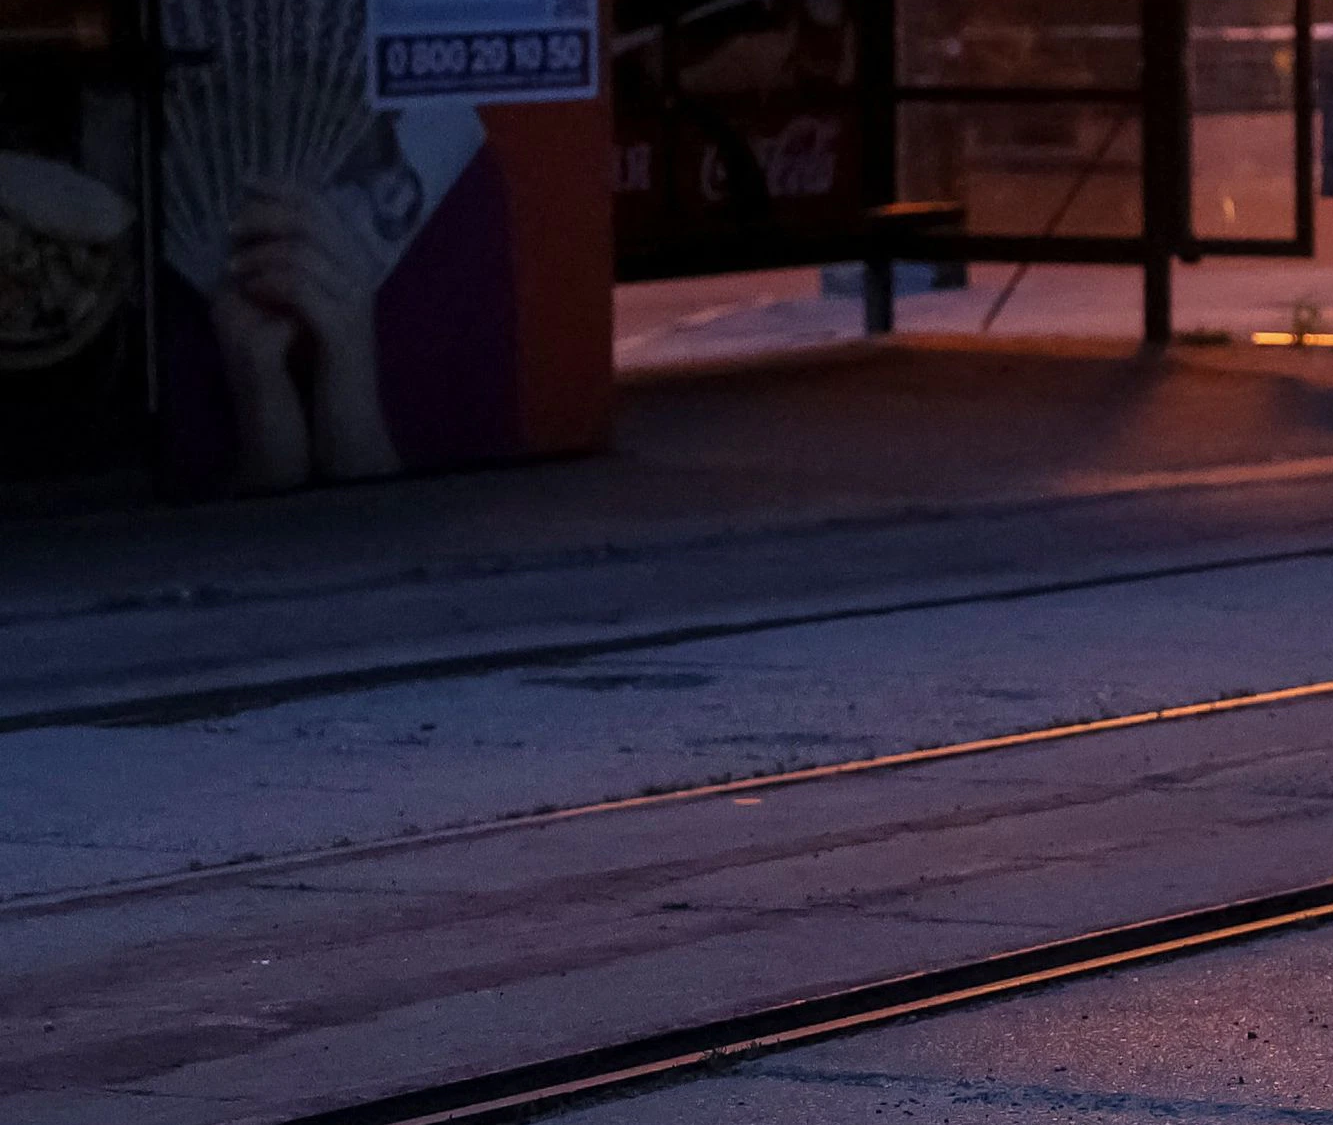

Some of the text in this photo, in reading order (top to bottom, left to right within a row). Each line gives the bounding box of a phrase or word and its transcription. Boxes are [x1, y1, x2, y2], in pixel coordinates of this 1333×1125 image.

[386, 33, 582, 77] 0 800 20 10 50
